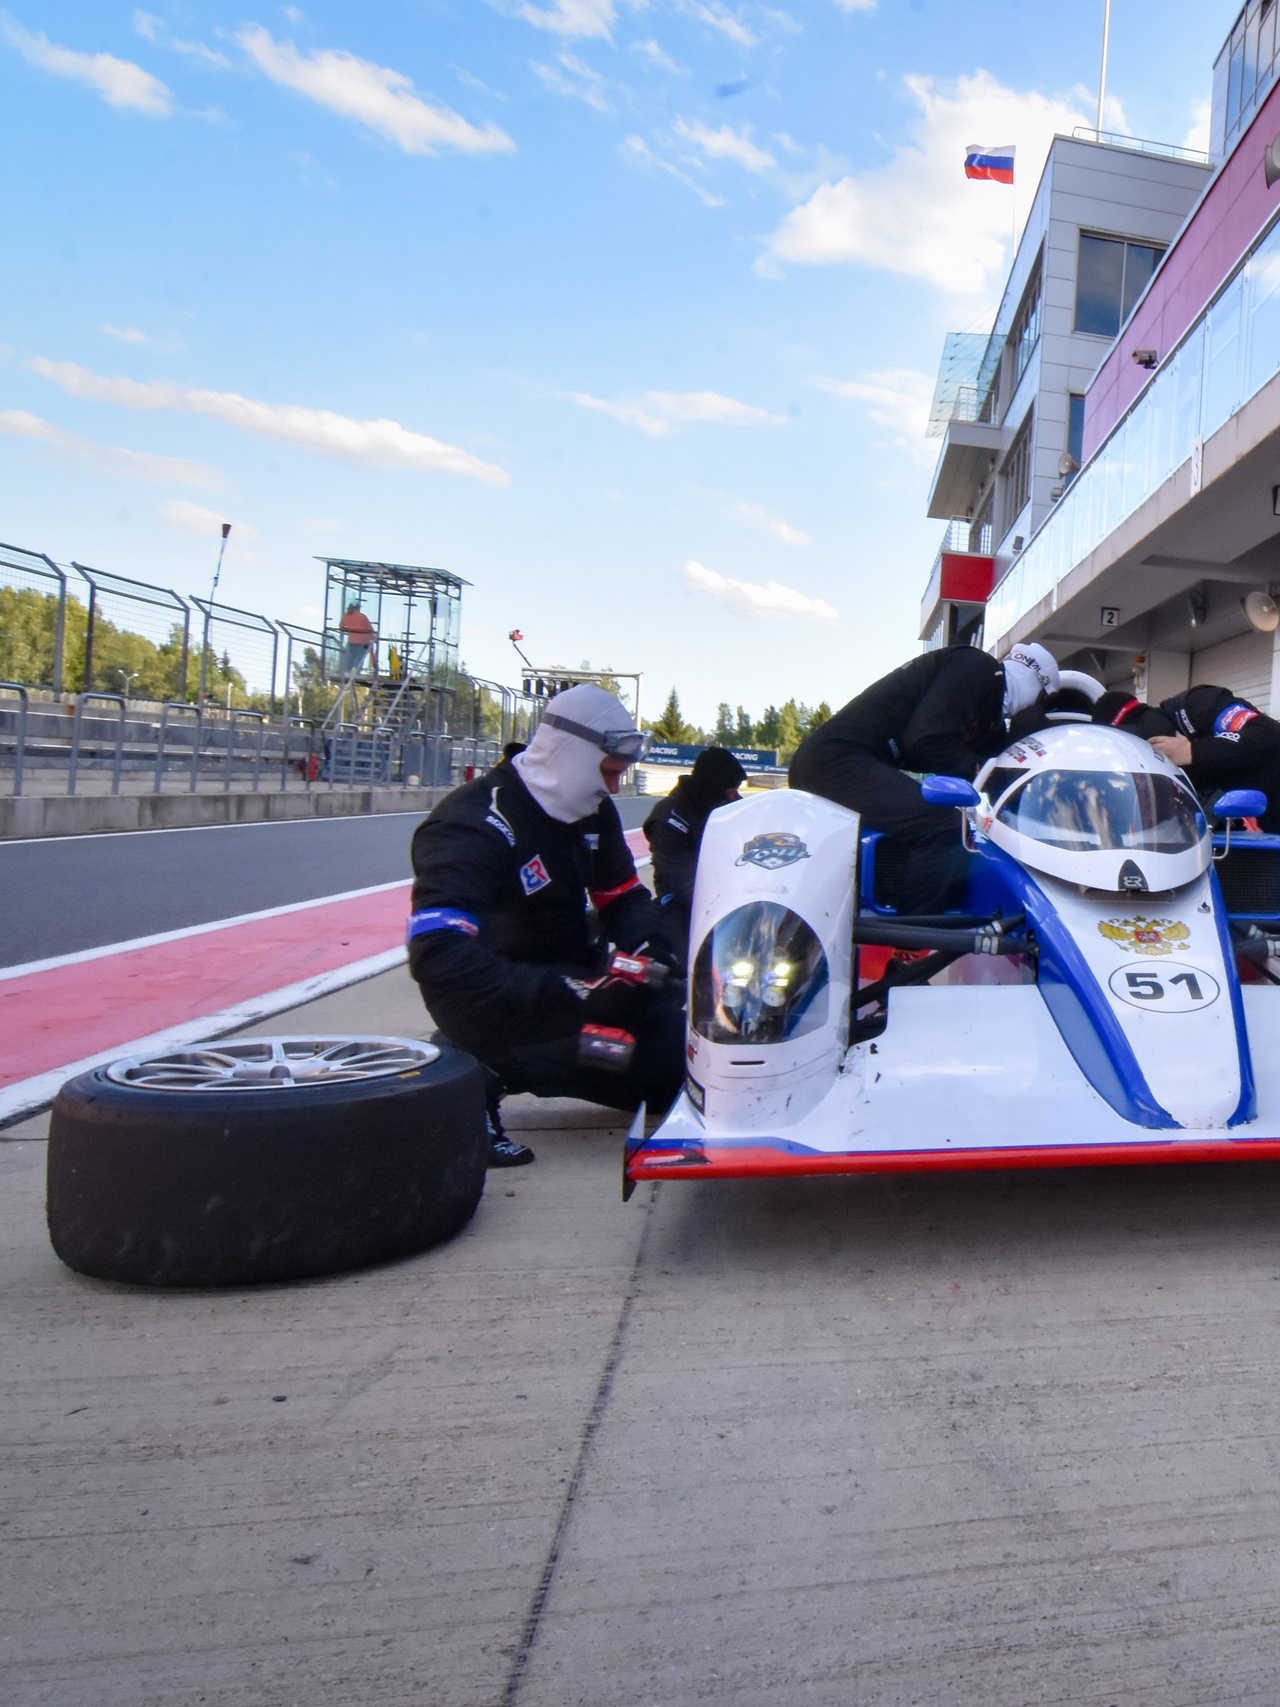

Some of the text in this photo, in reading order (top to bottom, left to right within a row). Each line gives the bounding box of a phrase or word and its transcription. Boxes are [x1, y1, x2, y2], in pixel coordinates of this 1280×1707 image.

[1107, 611, 1115, 624] 2
[649, 746, 678, 756] RACING
[731, 752, 759, 761] ACING
[1125, 972, 1204, 1000] 51
